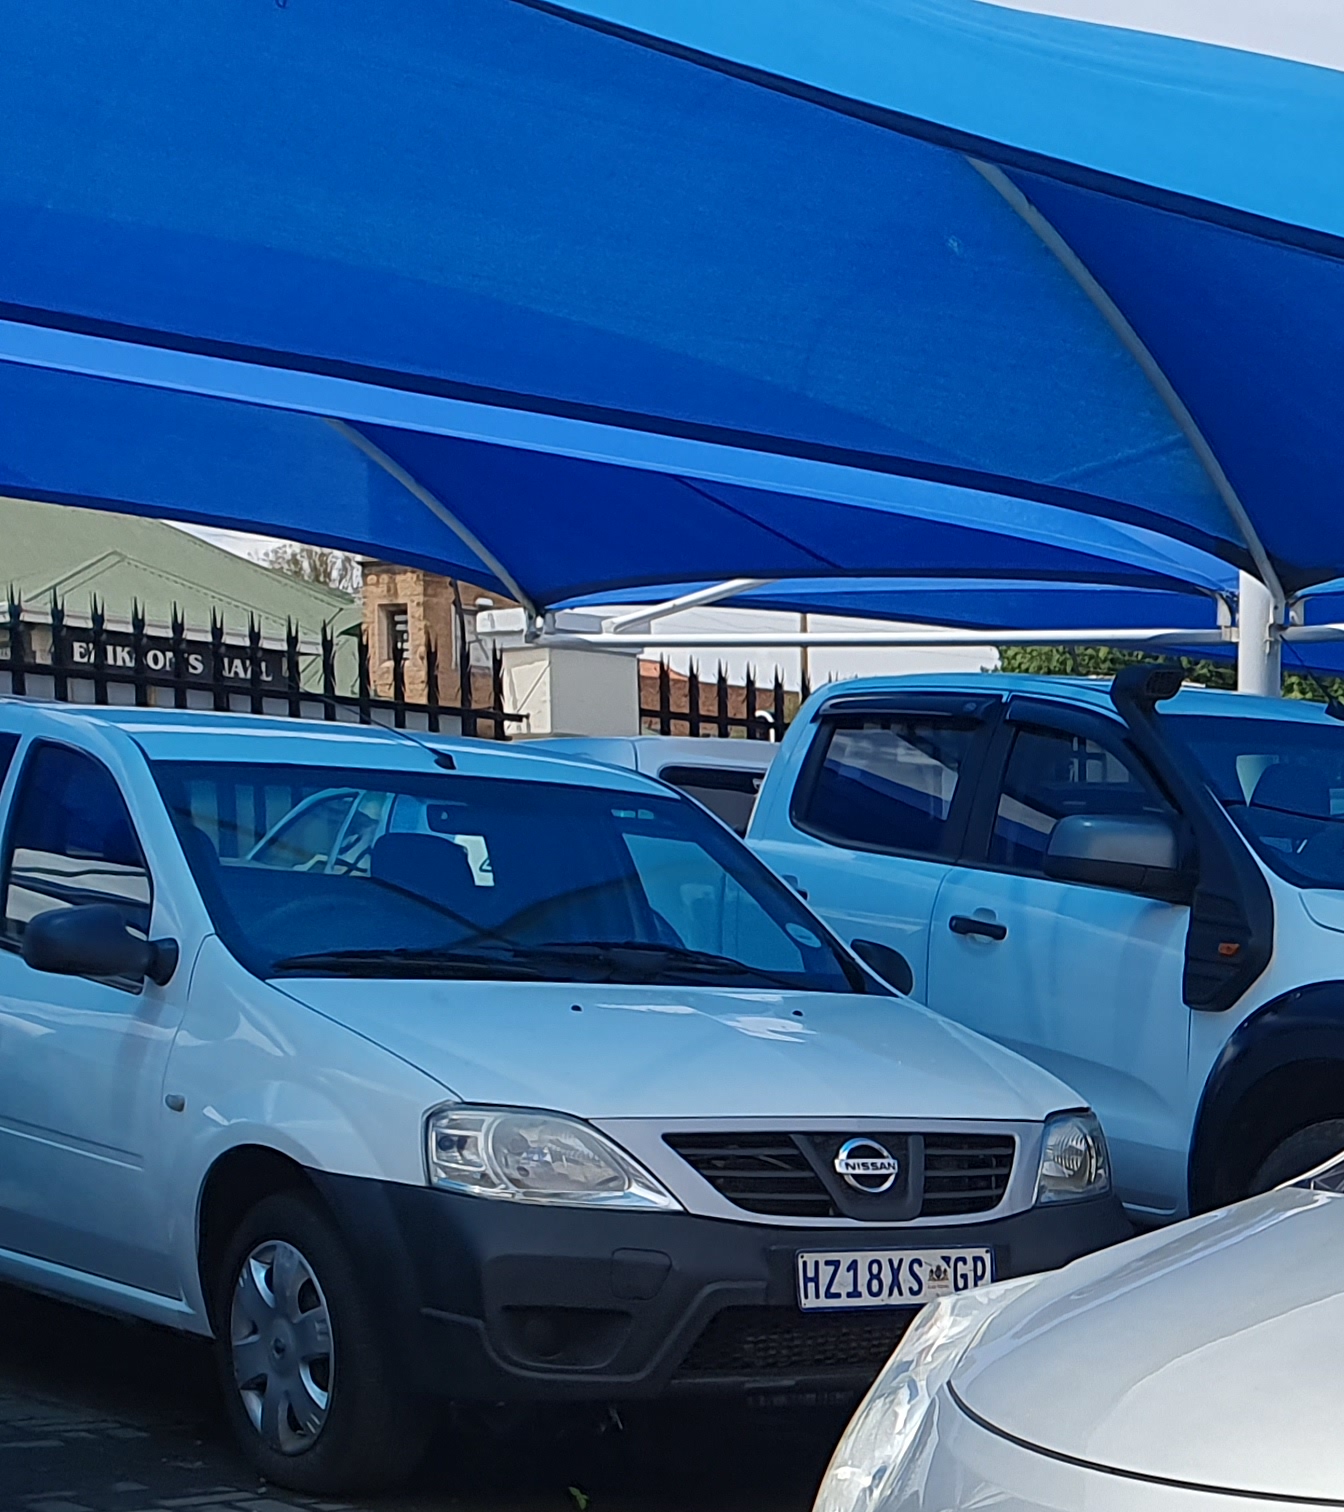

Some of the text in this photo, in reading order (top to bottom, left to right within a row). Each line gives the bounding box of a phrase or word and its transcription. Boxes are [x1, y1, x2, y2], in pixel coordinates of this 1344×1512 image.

[845, 1161, 897, 1171] NISSAN
[801, 1255, 987, 1300] HZ18XS GP
